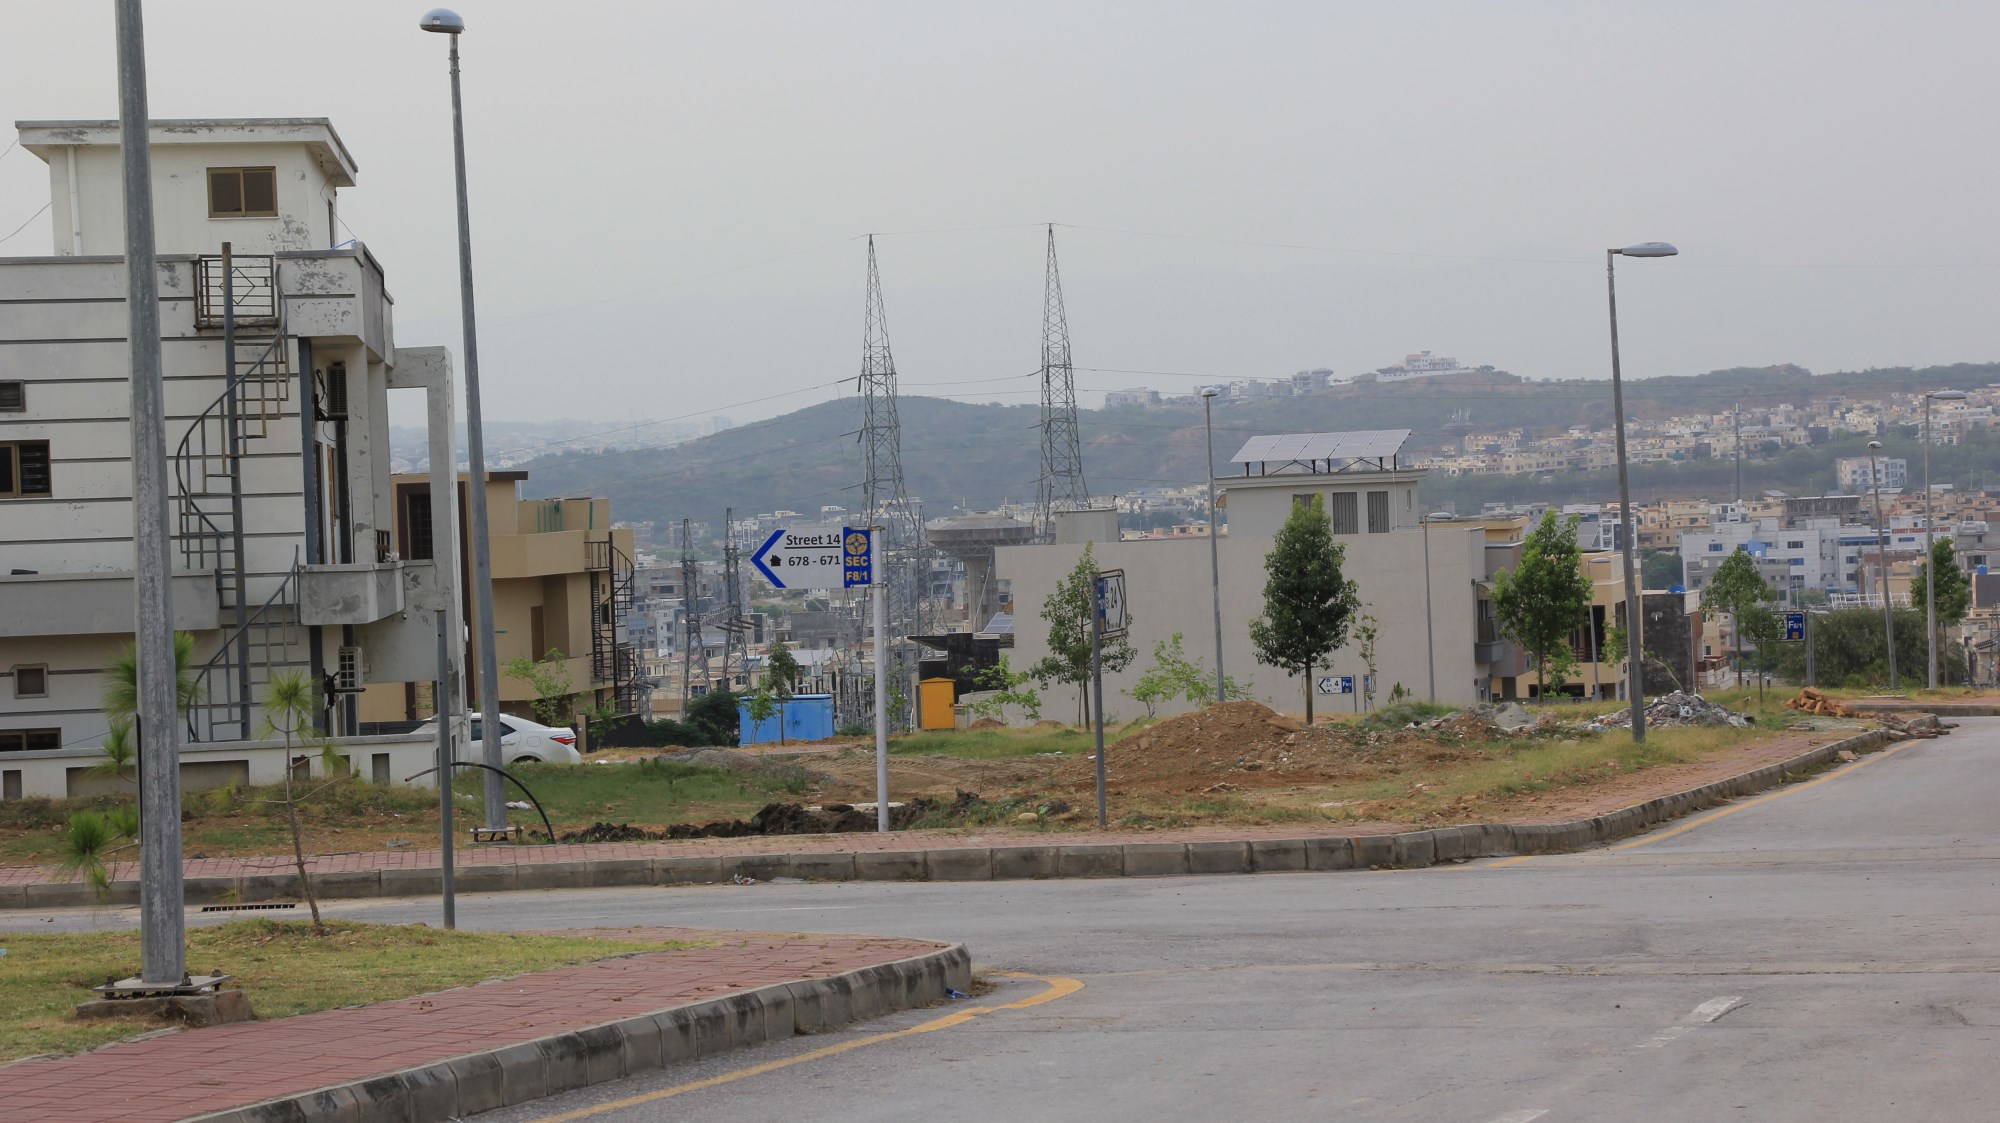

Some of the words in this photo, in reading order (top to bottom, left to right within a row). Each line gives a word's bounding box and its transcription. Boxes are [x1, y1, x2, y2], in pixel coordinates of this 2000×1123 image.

[786, 534, 823, 546] Street
[826, 533, 841, 545] 14
[788, 556, 810, 567] 678
[820, 555, 841, 566] 671
[845, 556, 868, 567] SEC
[846, 571, 868, 581] F8/1
[1110, 586, 1118, 609] 24
